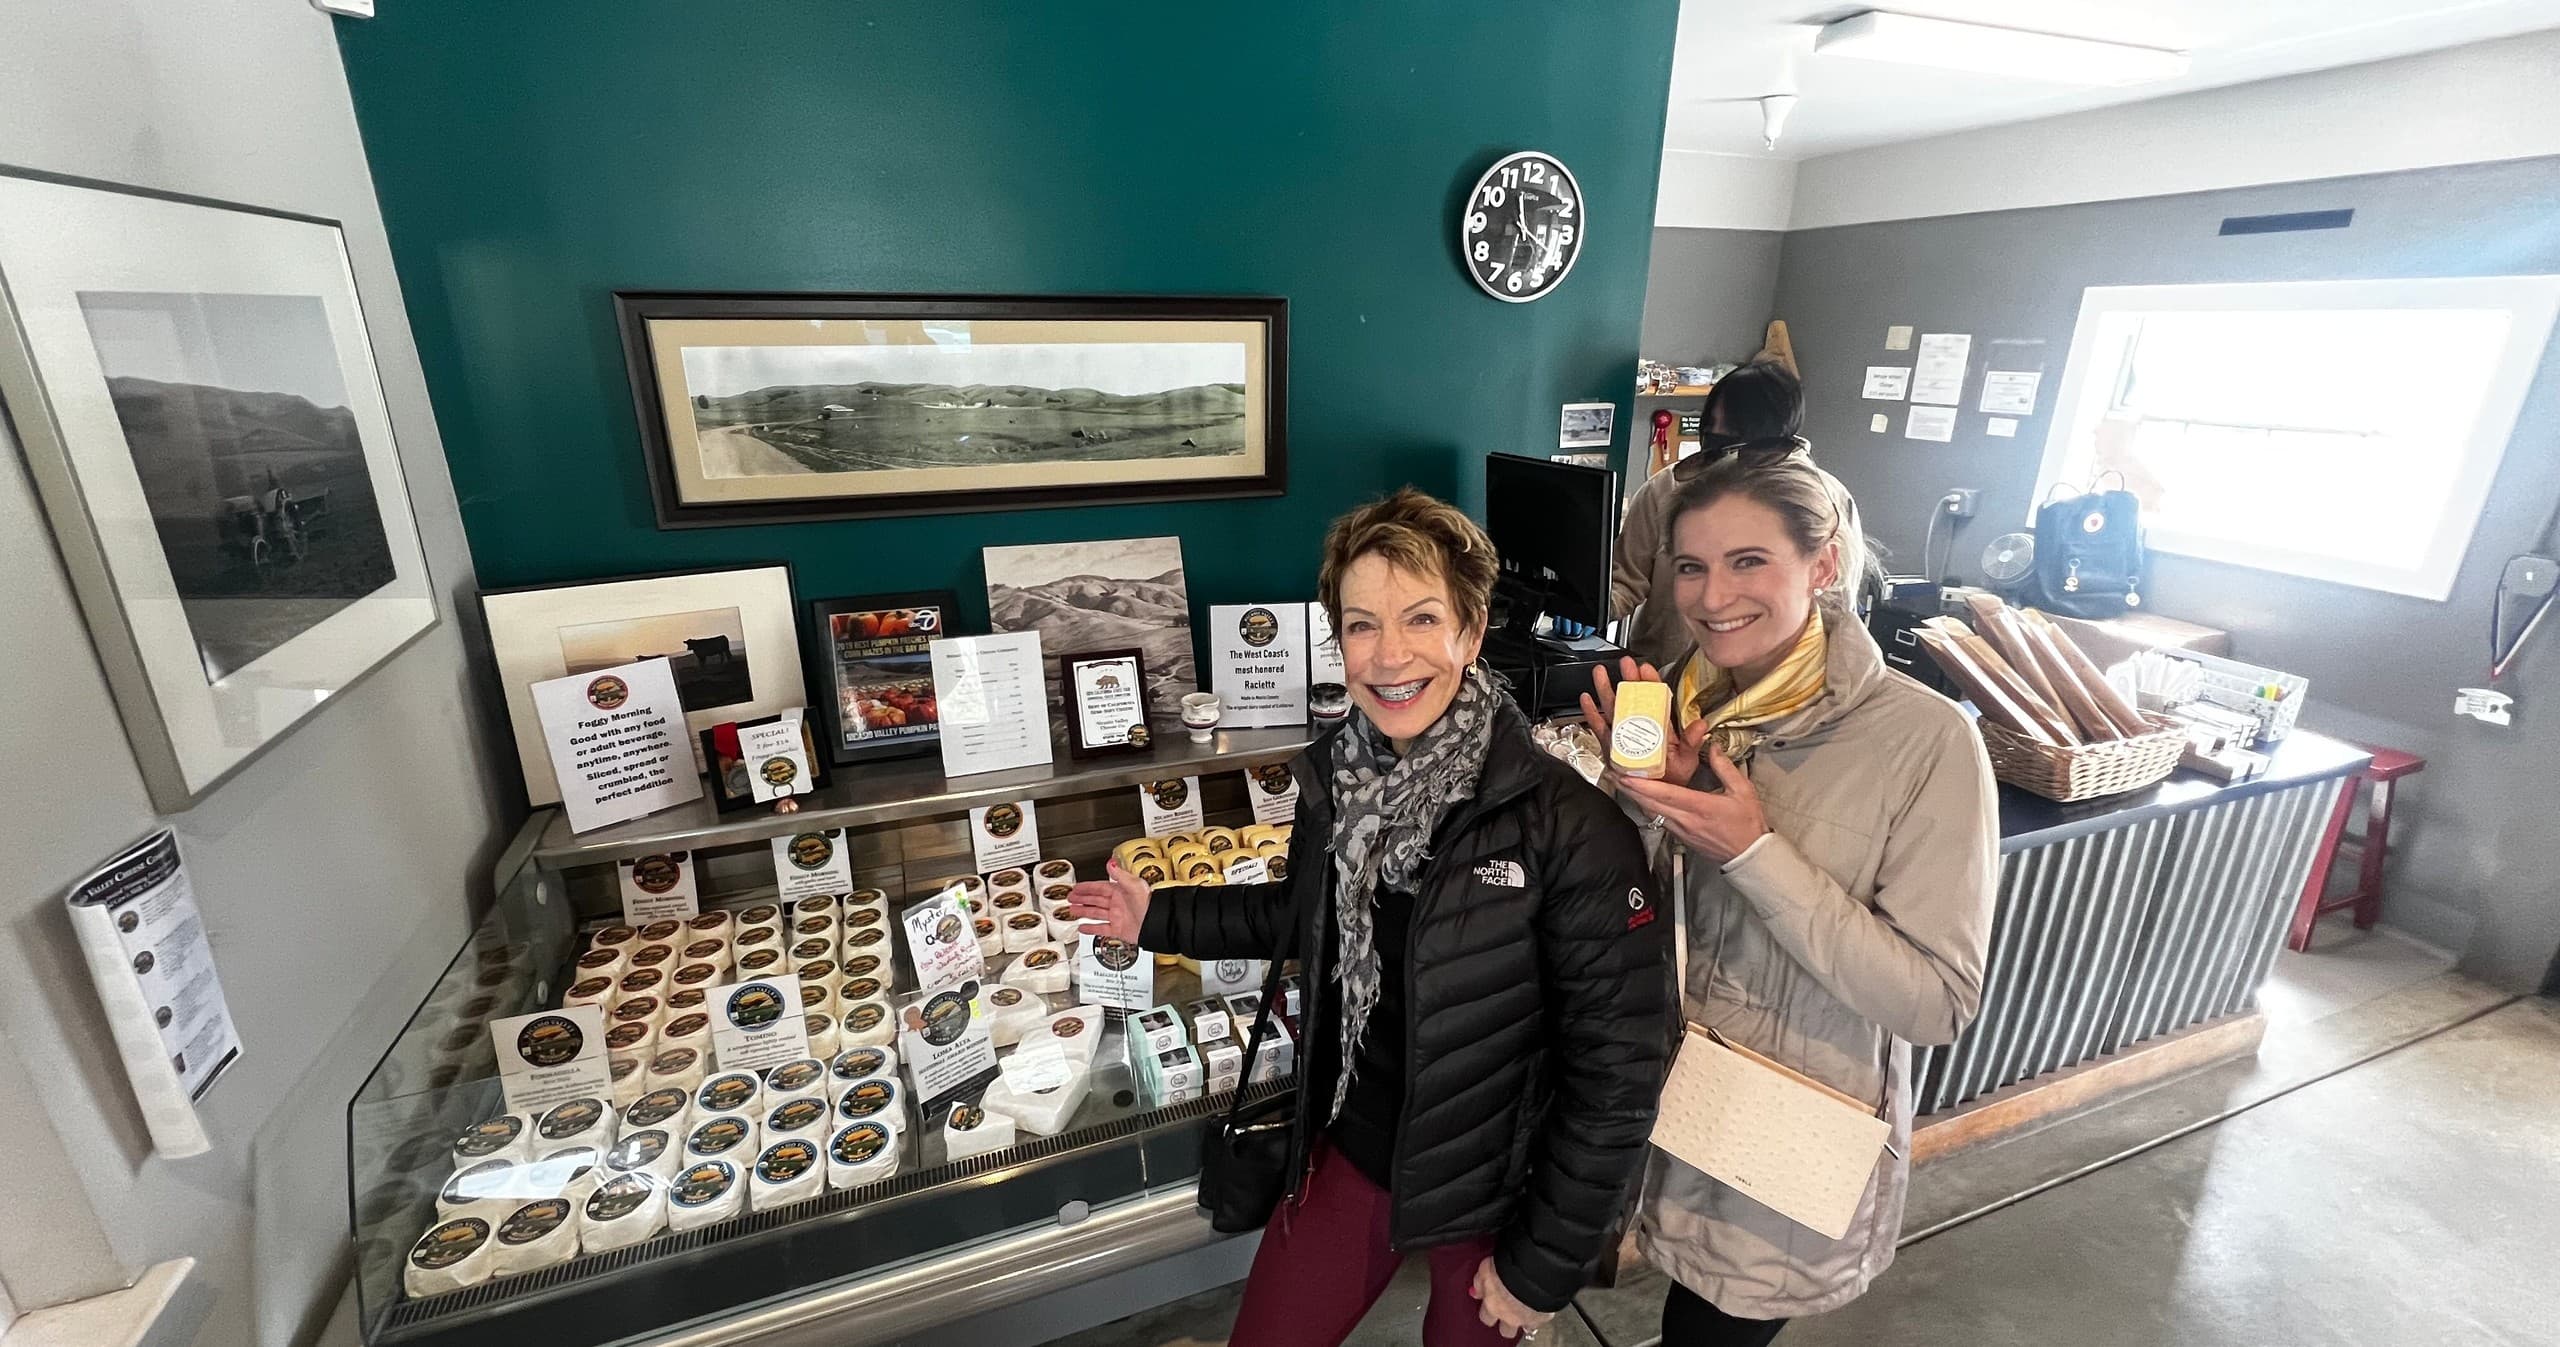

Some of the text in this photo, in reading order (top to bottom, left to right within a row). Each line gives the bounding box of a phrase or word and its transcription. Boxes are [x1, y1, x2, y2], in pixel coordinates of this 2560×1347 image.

[1500, 168, 1519, 189] 11
[1522, 161, 1545, 185] 12
[1550, 175, 1560, 196] 1
[1482, 186, 1506, 208] 10
[1559, 198, 1574, 218] 2
[1471, 211, 1488, 234] 9
[1560, 224, 1574, 246] 3
[1474, 240, 1490, 262] 8
[1549, 250, 1563, 271] 4
[1488, 261, 1506, 282] 7
[1507, 271, 1523, 293] 6
[1529, 265, 1545, 288] 5
[862, 647, 884, 657] MAZES
[870, 637, 899, 648] PUMPKIN
[1230, 648, 1289, 659] The West Coast's
[1235, 664, 1285, 674] most honored
[1244, 680, 1276, 690] Raclette
[578, 707, 653, 729] Foggy Morning
[570, 716, 666, 746] Good with any food
[873, 728, 898, 738] VALLEY
[899, 724, 928, 735] PUMPKIN
[576, 730, 667, 757] or adult beverage,
[576, 741, 673, 770] anytime, anywhere.
[586, 767, 622, 781] Sliced,
[623, 757, 657, 772] spread
[598, 768, 665, 791] crumbled, the
[595, 777, 674, 805] perfect addition
[1472, 866, 1508, 877] NORTH
[1489, 860, 1509, 869] THE
[1481, 876, 1508, 886] FACE
[744, 1032, 777, 1042] TOMINO
[932, 1038, 971, 1060] LOMA ALTA
